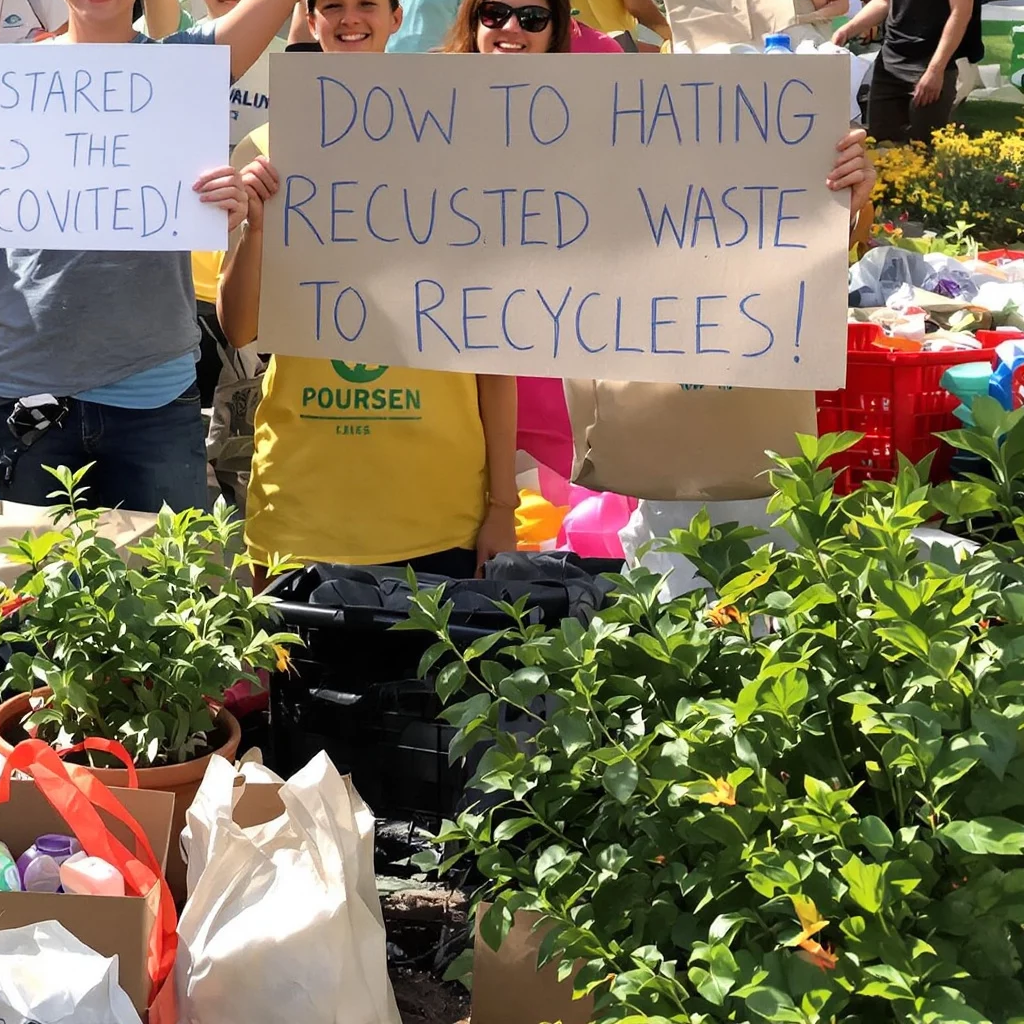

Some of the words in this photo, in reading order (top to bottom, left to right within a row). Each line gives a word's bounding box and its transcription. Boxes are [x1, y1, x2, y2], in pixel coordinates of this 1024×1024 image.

[317, 76, 457, 148] DOW
[490, 83, 570, 148] TO
[611, 78, 817, 148] HATING
[65, 132, 131, 168] THE
[283, 174, 590, 250] RECUSTED
[638, 184, 808, 249] WASTE
[299, 279, 367, 343] TO
[414, 278, 807, 364] RECYCLEES!
[302, 387, 421, 410] POURSEN
